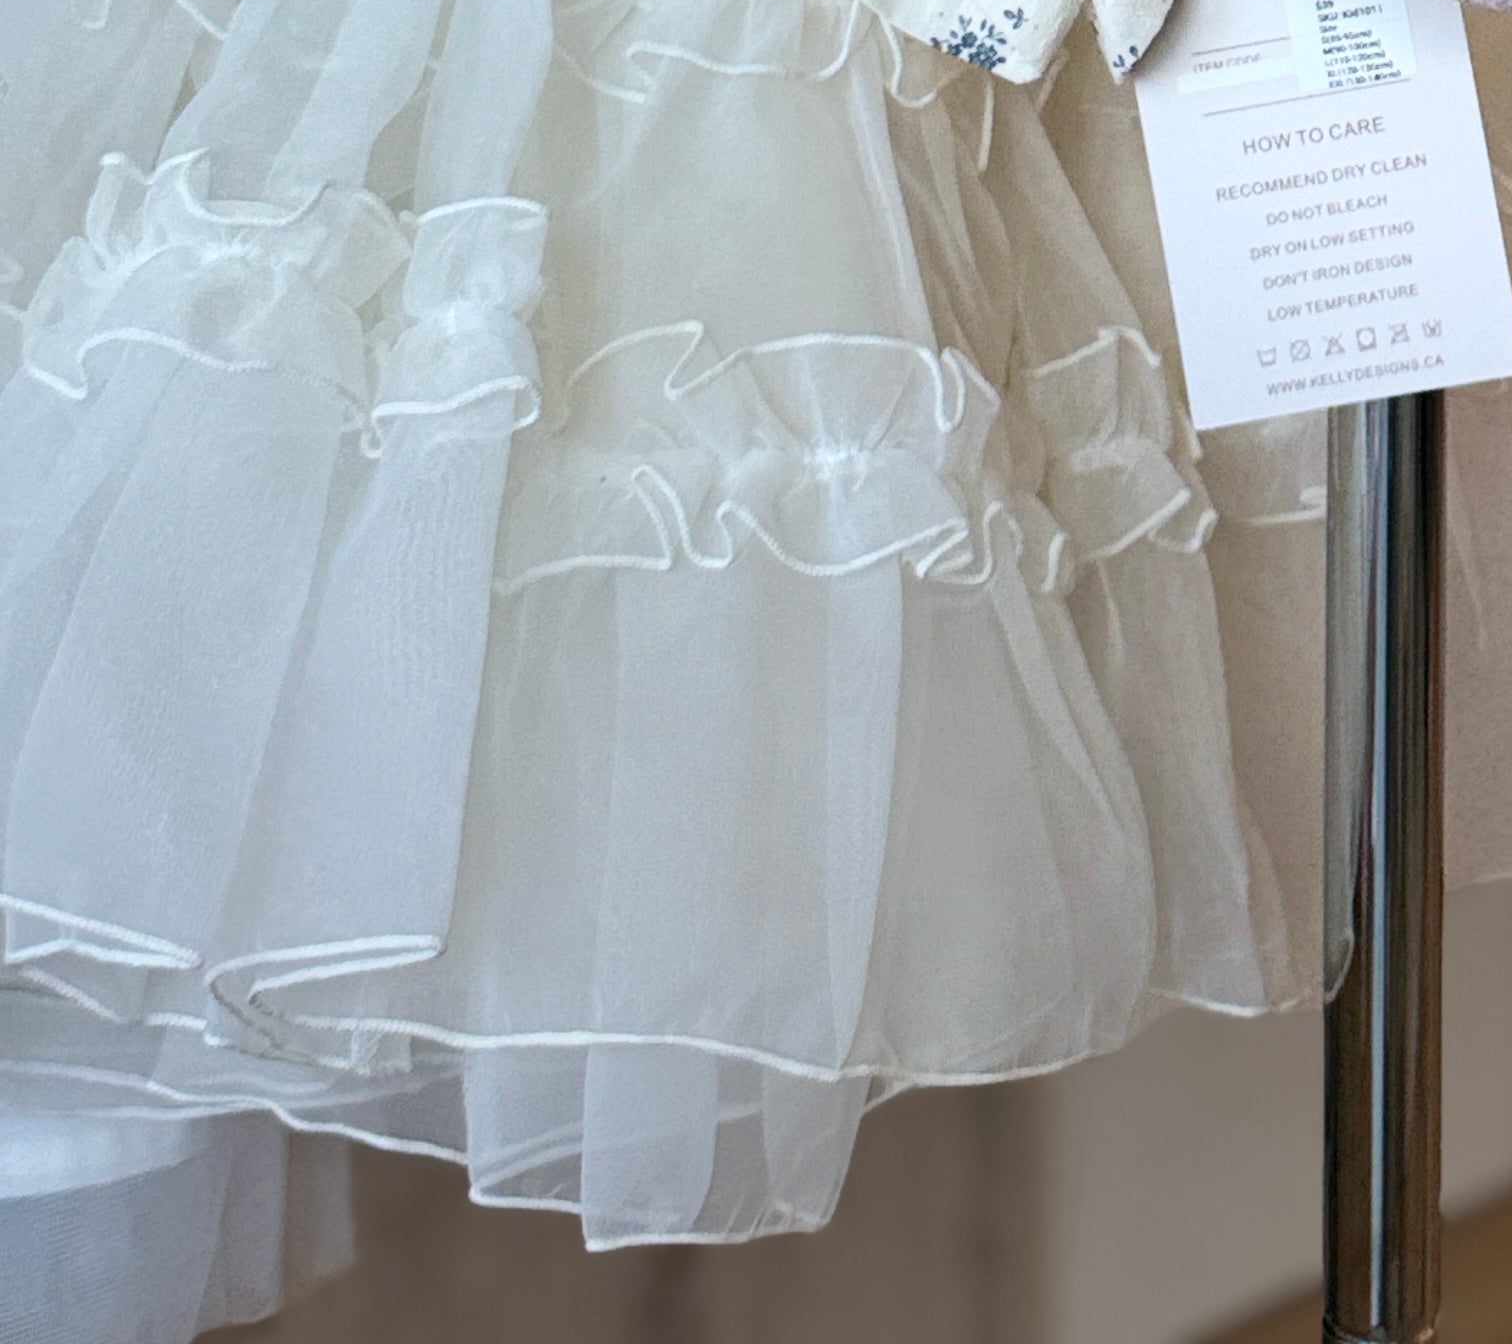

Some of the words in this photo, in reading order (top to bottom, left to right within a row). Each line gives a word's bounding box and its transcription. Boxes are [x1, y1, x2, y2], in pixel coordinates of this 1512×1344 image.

[1242, 132, 1291, 155] HOW
[1295, 127, 1324, 146] TO
[1329, 116, 1386, 141] CARE
[1216, 170, 1328, 202] RECOMMEND
[1332, 163, 1367, 182] DRY
[1370, 153, 1427, 176] CLEAN
[1266, 210, 1289, 226] DO
[1292, 205, 1323, 221] NOT
[1327, 194, 1388, 216] BLEACH
[1249, 243, 1281, 261] DRY
[1284, 238, 1307, 255] ON
[1310, 232, 1345, 251] LOW
[1349, 220, 1415, 244] SETTING
[1263, 269, 1308, 291] DON'T
[1312, 264, 1350, 281] IRON
[1354, 253, 1413, 275] DESIGN
[1267, 304, 1302, 322] LOW
[1305, 282, 1420, 315] TEMPERATURE
